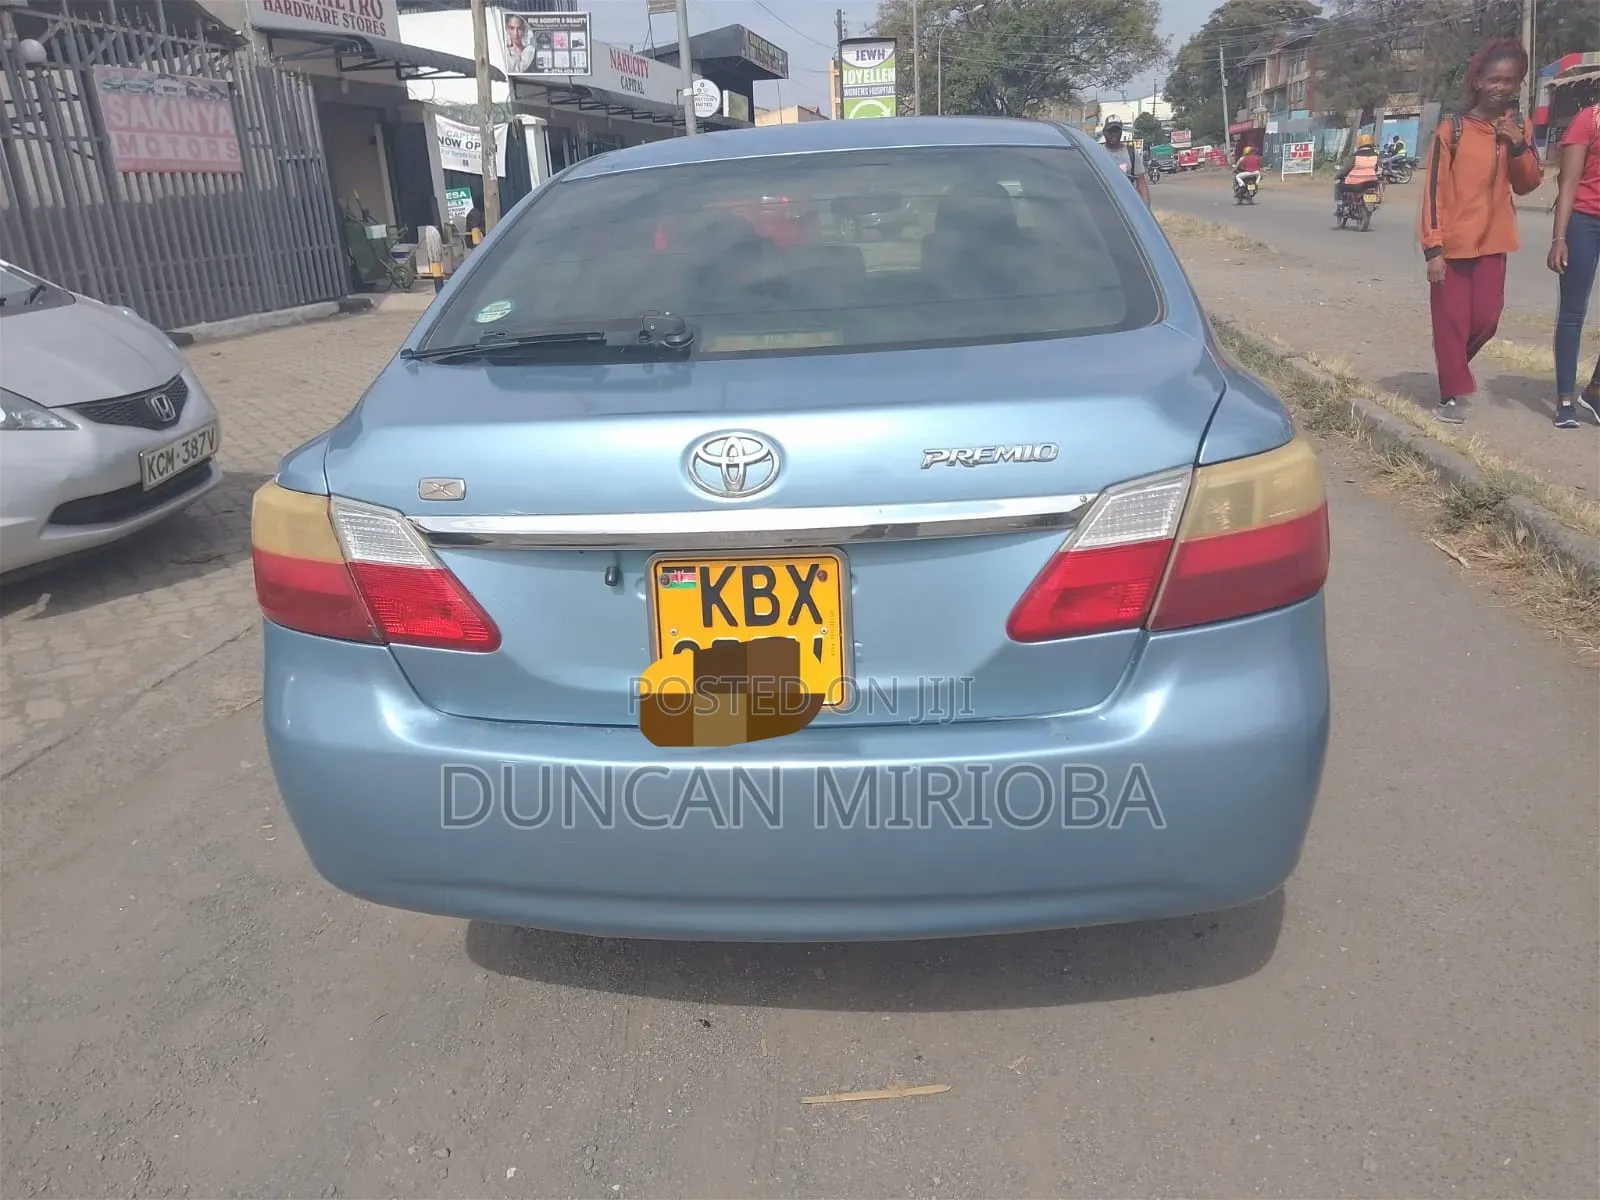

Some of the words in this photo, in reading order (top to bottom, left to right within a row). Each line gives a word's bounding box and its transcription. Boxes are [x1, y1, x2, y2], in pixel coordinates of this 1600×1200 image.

[263, 0, 340, 26] HARDWARE
[342, 13, 387, 37] STORES
[609, 48, 649, 79] NAKUCITY
[856, 48, 886, 62] JEWH
[620, 76, 645, 95] CAPITAL
[869, 85, 896, 96] HOSPITAL
[107, 93, 236, 135] SAKINYA
[116, 133, 239, 161] MOTORS
[437, 135, 462, 149] NOW
[446, 130, 482, 142] CAPITA
[446, 191, 468, 200] ESA
[921, 443, 1060, 470] PREMIO
[700, 563, 824, 628] KBX
